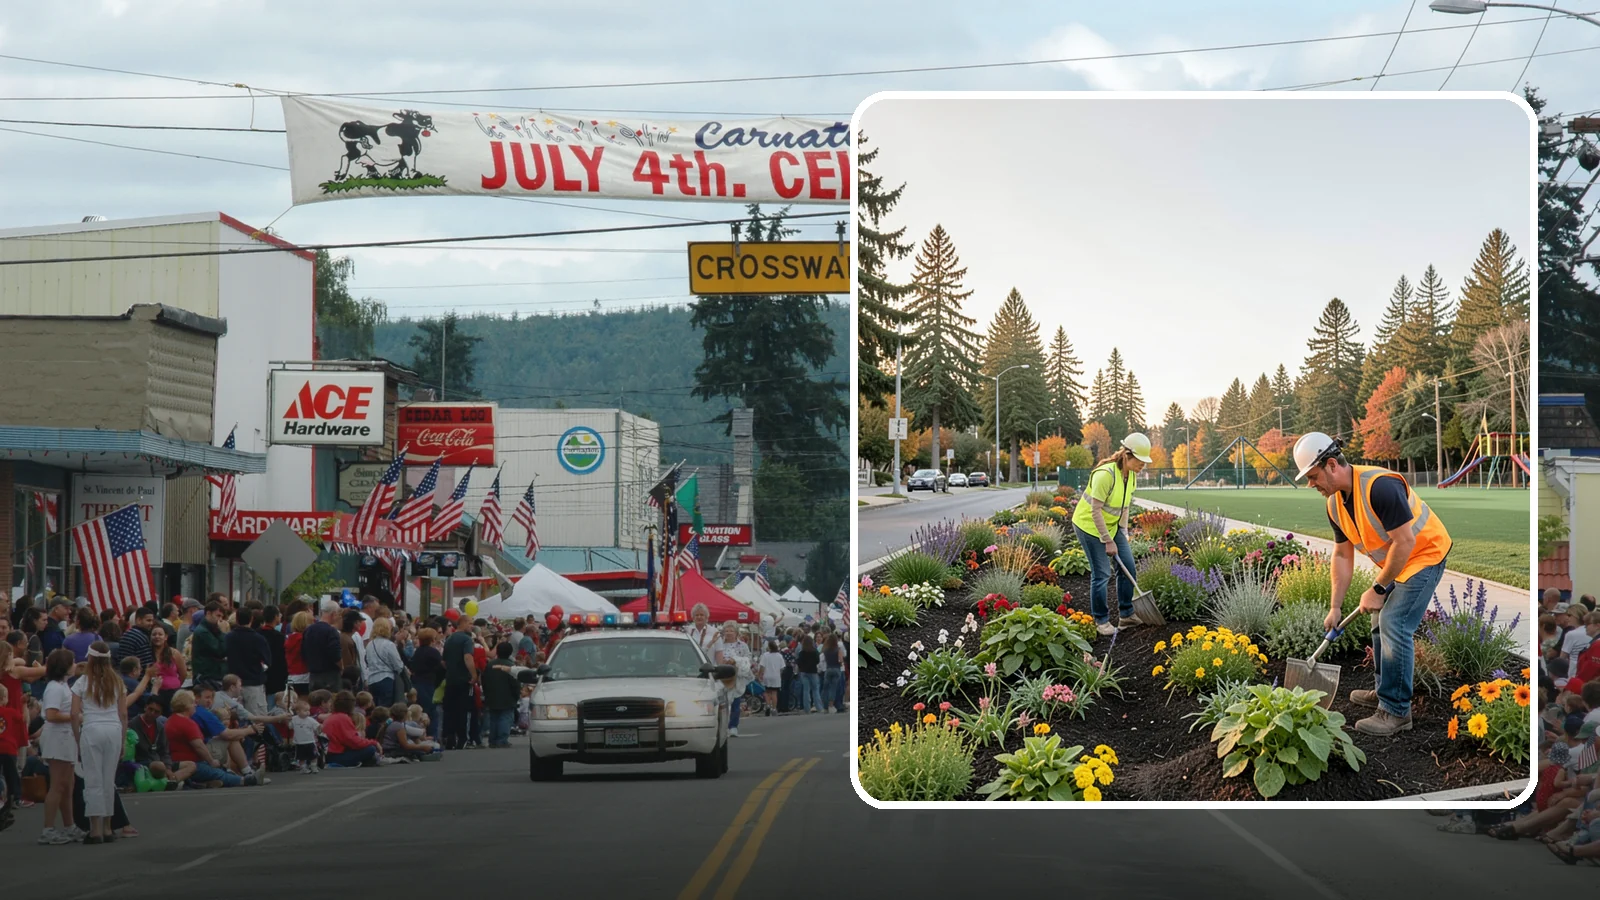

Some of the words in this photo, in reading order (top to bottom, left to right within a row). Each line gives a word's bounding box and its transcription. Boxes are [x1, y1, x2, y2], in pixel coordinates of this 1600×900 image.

[481, 141, 605, 192] JULY
[632, 150, 747, 198] 4th.
[697, 254, 850, 280] CROSSWA
[283, 380, 373, 420] ACE
[406, 409, 452, 421] CEDAR
[283, 421, 371, 436] Hardware
[416, 428, 477, 447] Coca-Cola
[354, 467, 387, 480] Simpl
[83, 485, 93, 494] St.
[95, 485, 124, 495] Vincent
[126, 486, 135, 494] de
[137, 486, 155, 495] Paul
[213, 516, 331, 536] HARDARE
[688, 526, 742, 535] CRNATION
[699, 535, 730, 543] GLASS
